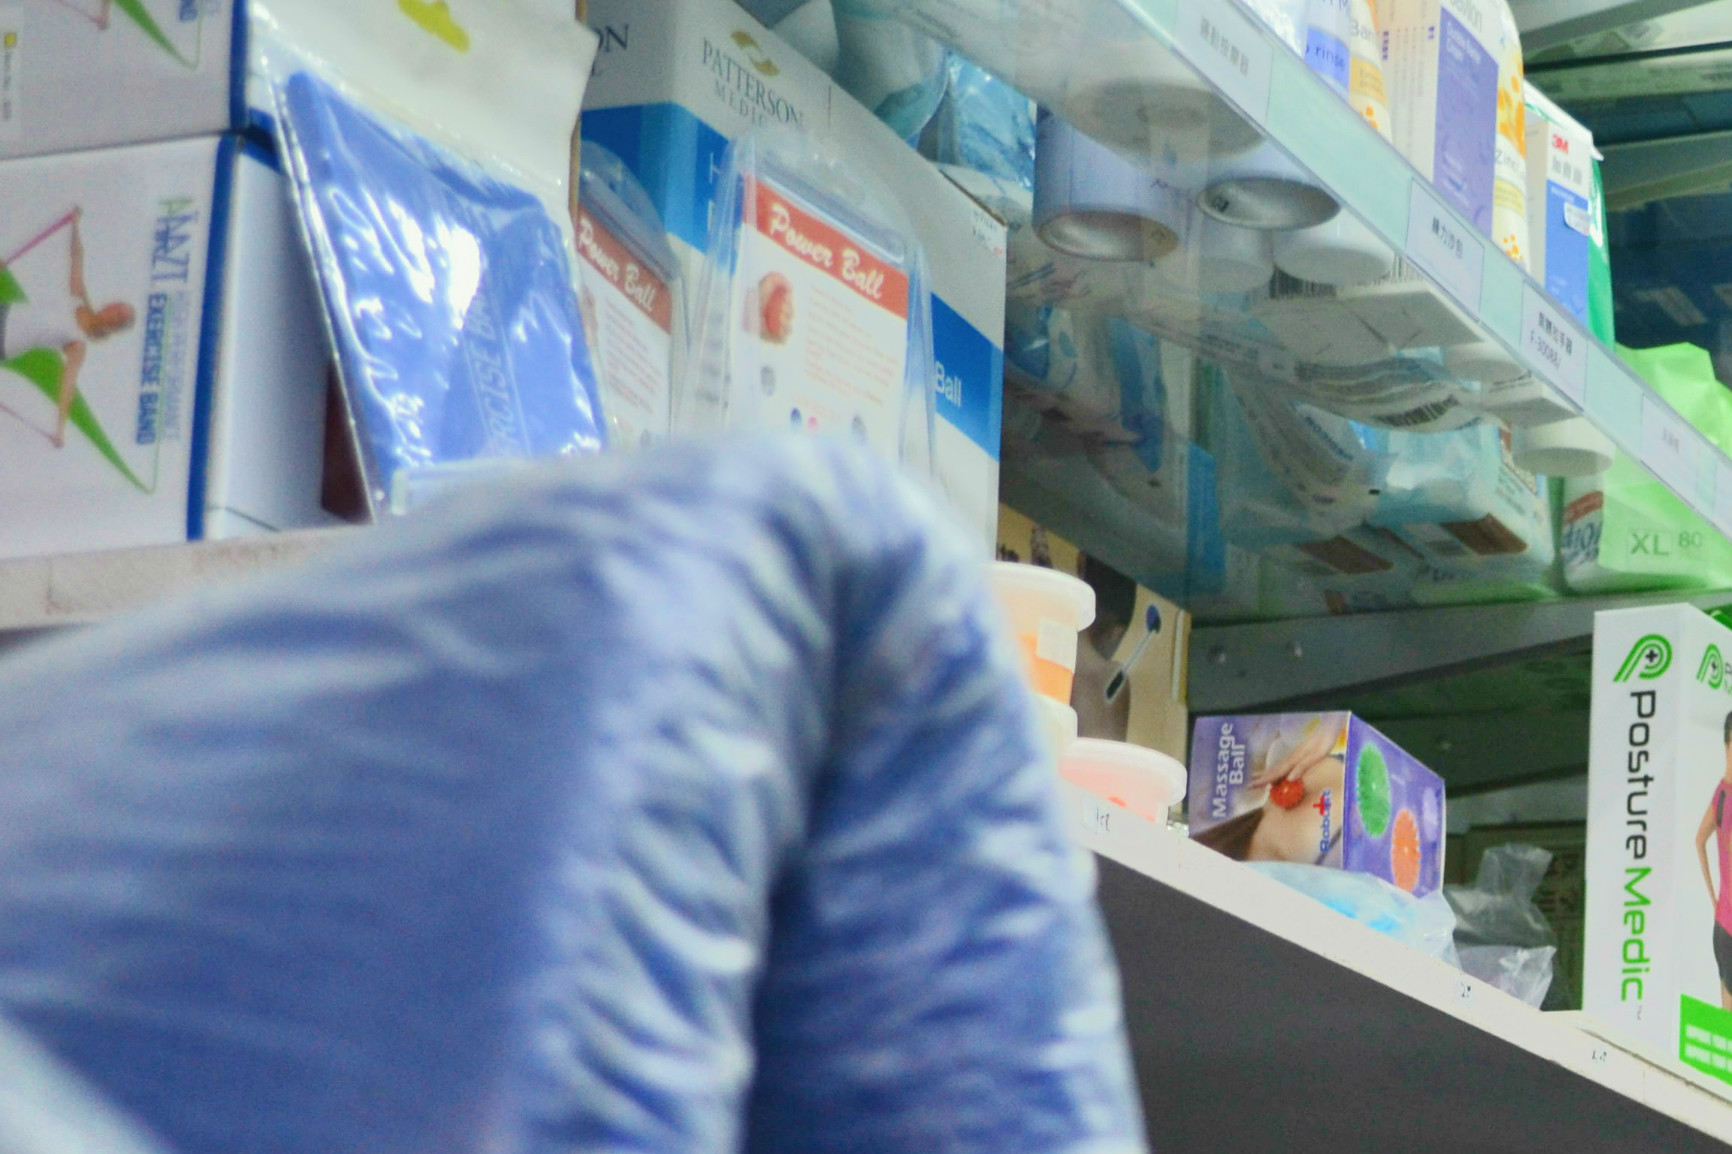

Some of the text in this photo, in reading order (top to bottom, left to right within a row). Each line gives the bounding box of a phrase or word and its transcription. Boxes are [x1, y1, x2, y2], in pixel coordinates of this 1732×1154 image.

[702, 37, 803, 127] PATTERSON
[1552, 134, 1569, 154] 3M
[578, 217, 654, 312] Power Ball
[769, 203, 886, 300] Power Ball
[936, 361, 962, 407] Ball
[1630, 531, 1669, 556] XL
[1213, 722, 1236, 818] Massage
[1229, 743, 1246, 785] Ball
[1621, 690, 1656, 1001] Posture Medic
